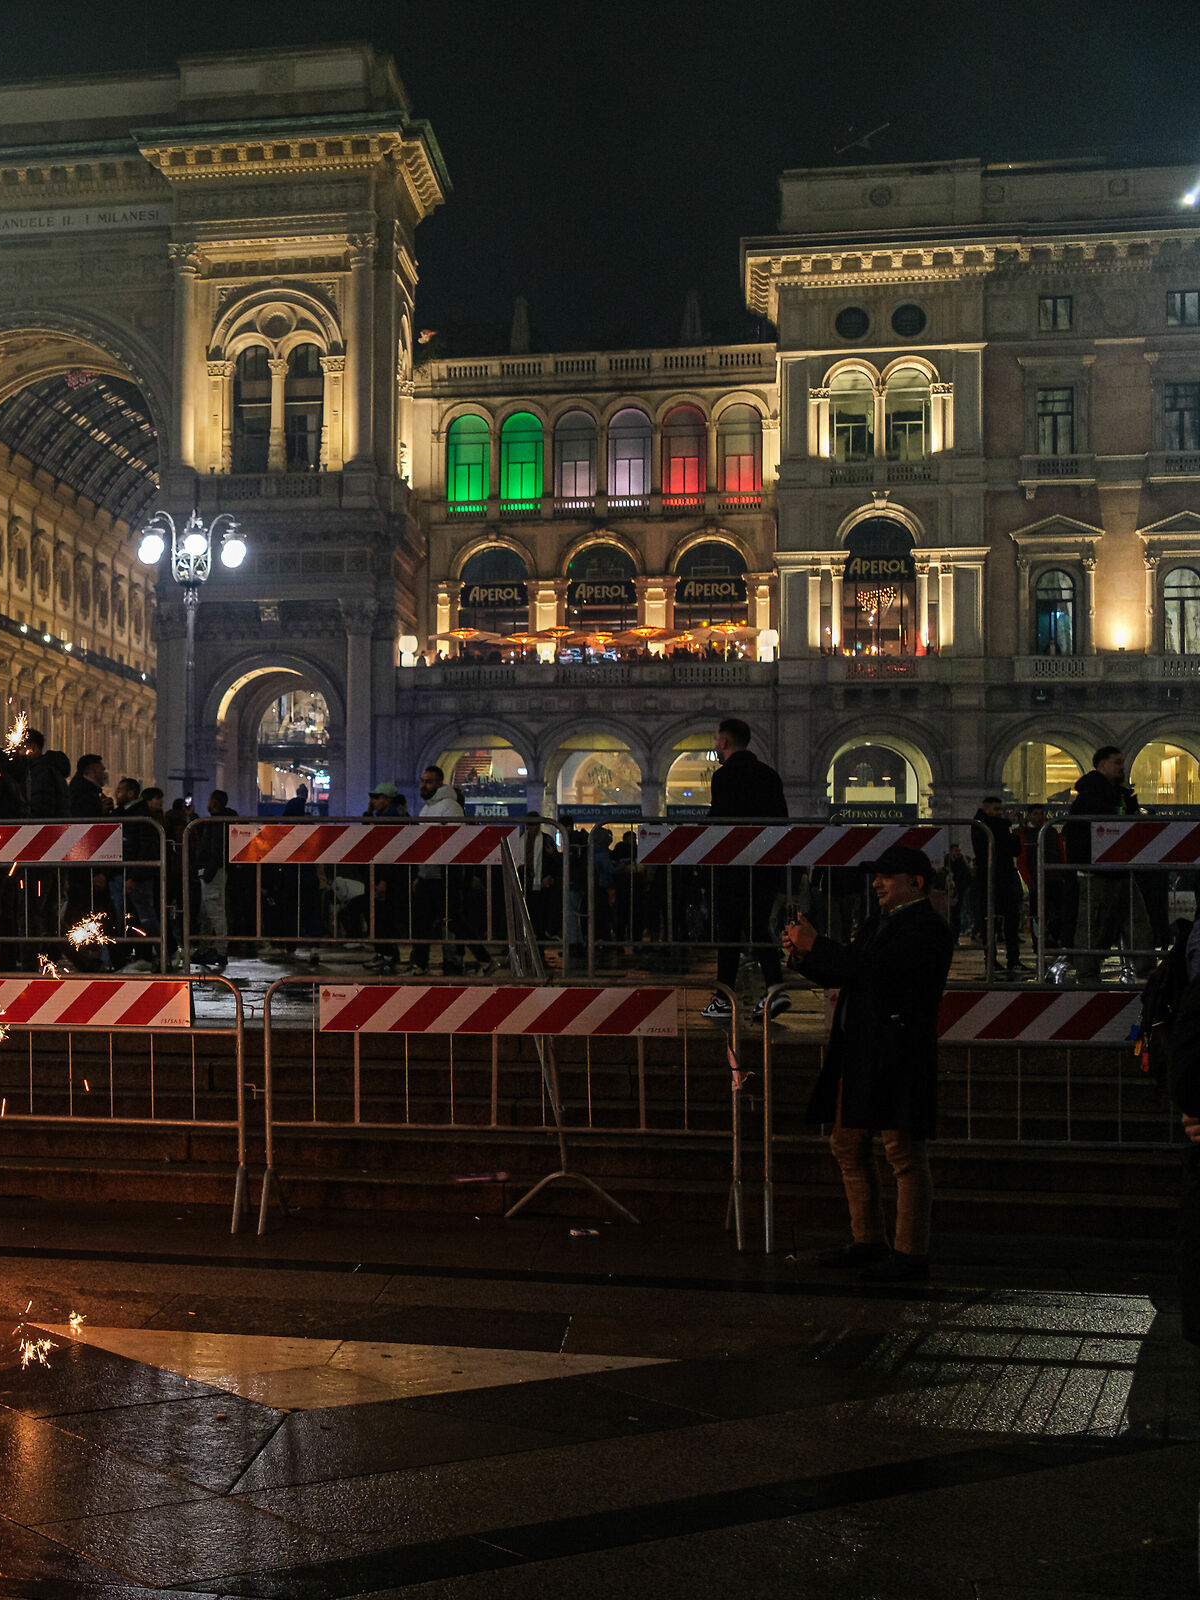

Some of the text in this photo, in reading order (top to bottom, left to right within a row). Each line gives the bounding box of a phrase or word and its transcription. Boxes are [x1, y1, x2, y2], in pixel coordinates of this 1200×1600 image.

[85, 213, 89, 225] I
[97, 210, 159, 224] MILANESI
[848, 557, 909, 575] APEROL
[469, 585, 522, 602] APEROL
[575, 583, 629, 600] APEROL
[683, 580, 739, 598] APEROL
[475, 805, 509, 816] Motta
[611, 808, 641, 816] DUOMO
